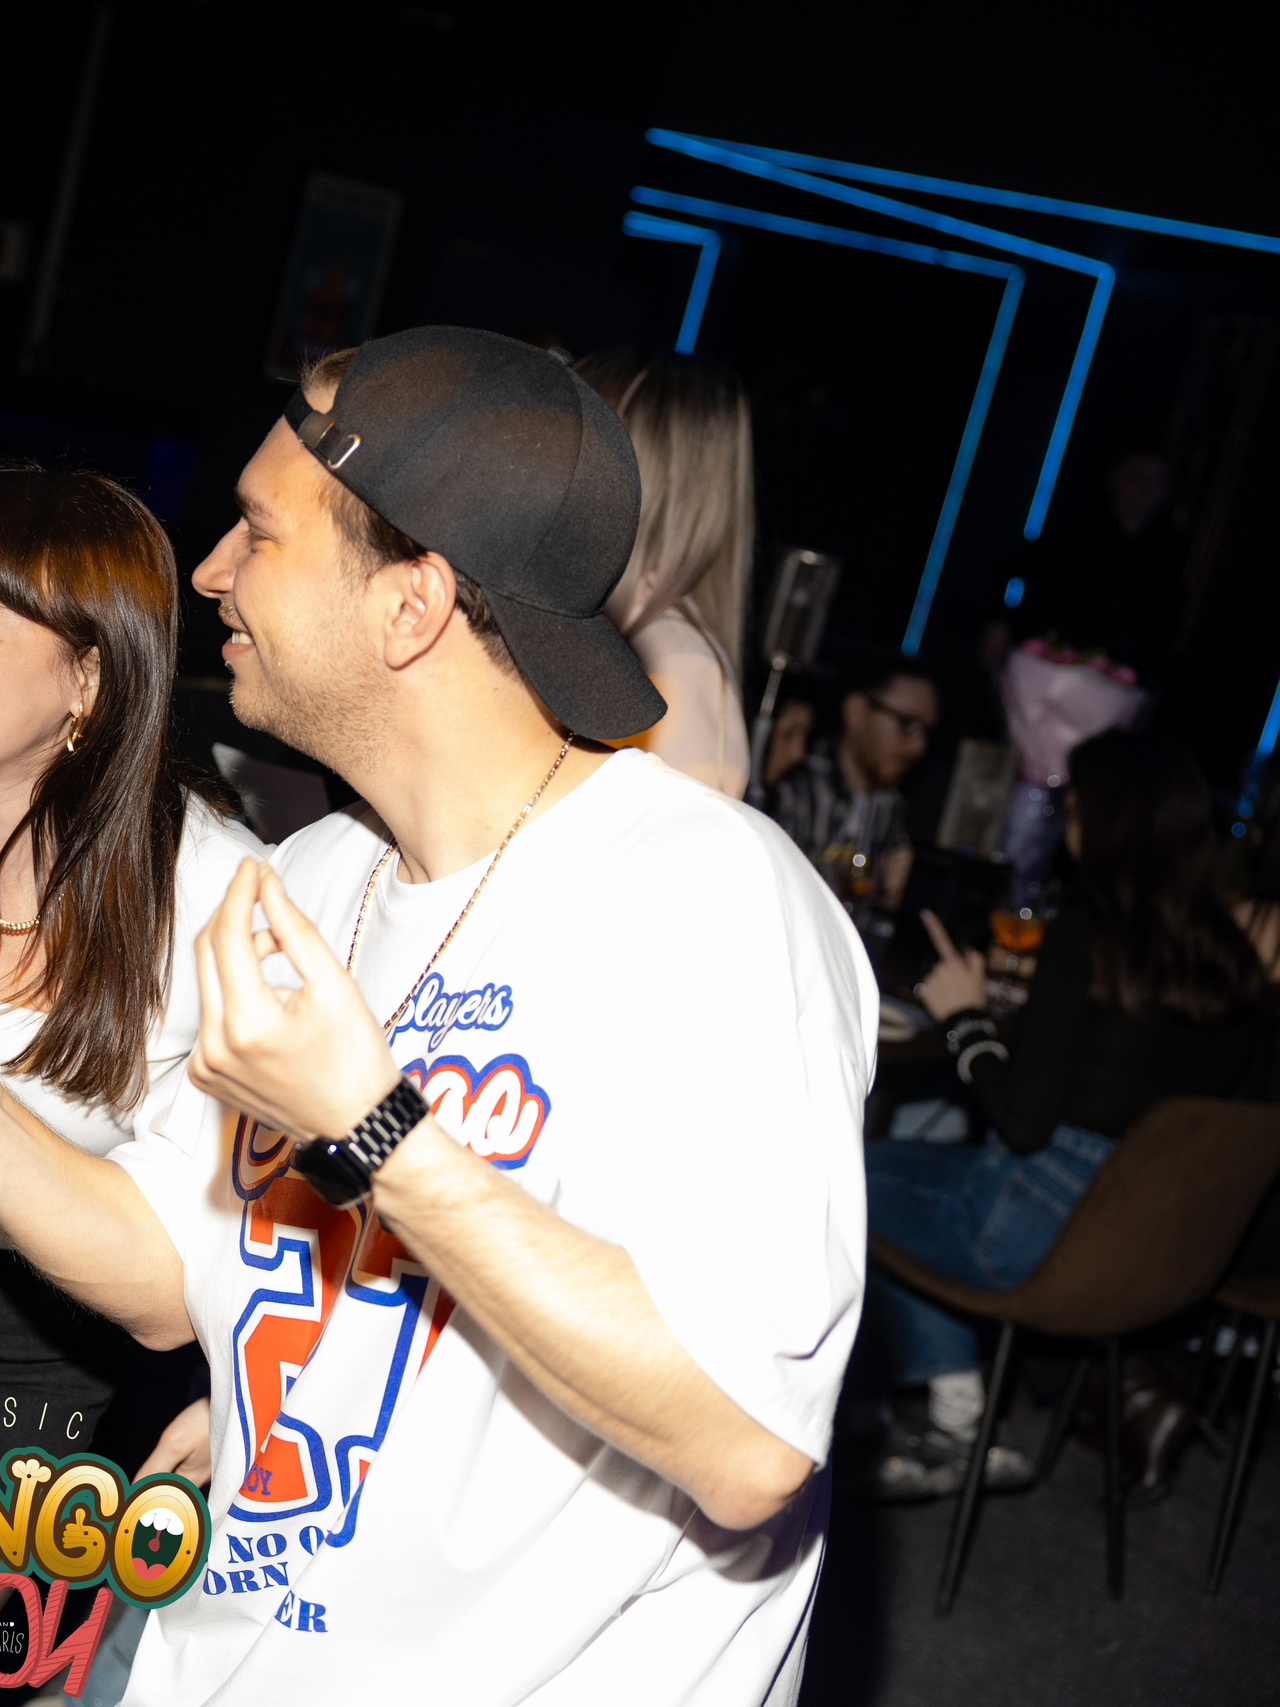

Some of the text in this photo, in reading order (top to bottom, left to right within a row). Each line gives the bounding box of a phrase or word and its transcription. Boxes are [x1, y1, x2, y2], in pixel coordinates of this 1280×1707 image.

[226, 1532, 287, 1564] NO
[202, 1561, 290, 1596] ORN
[274, 1589, 329, 1633] ER
